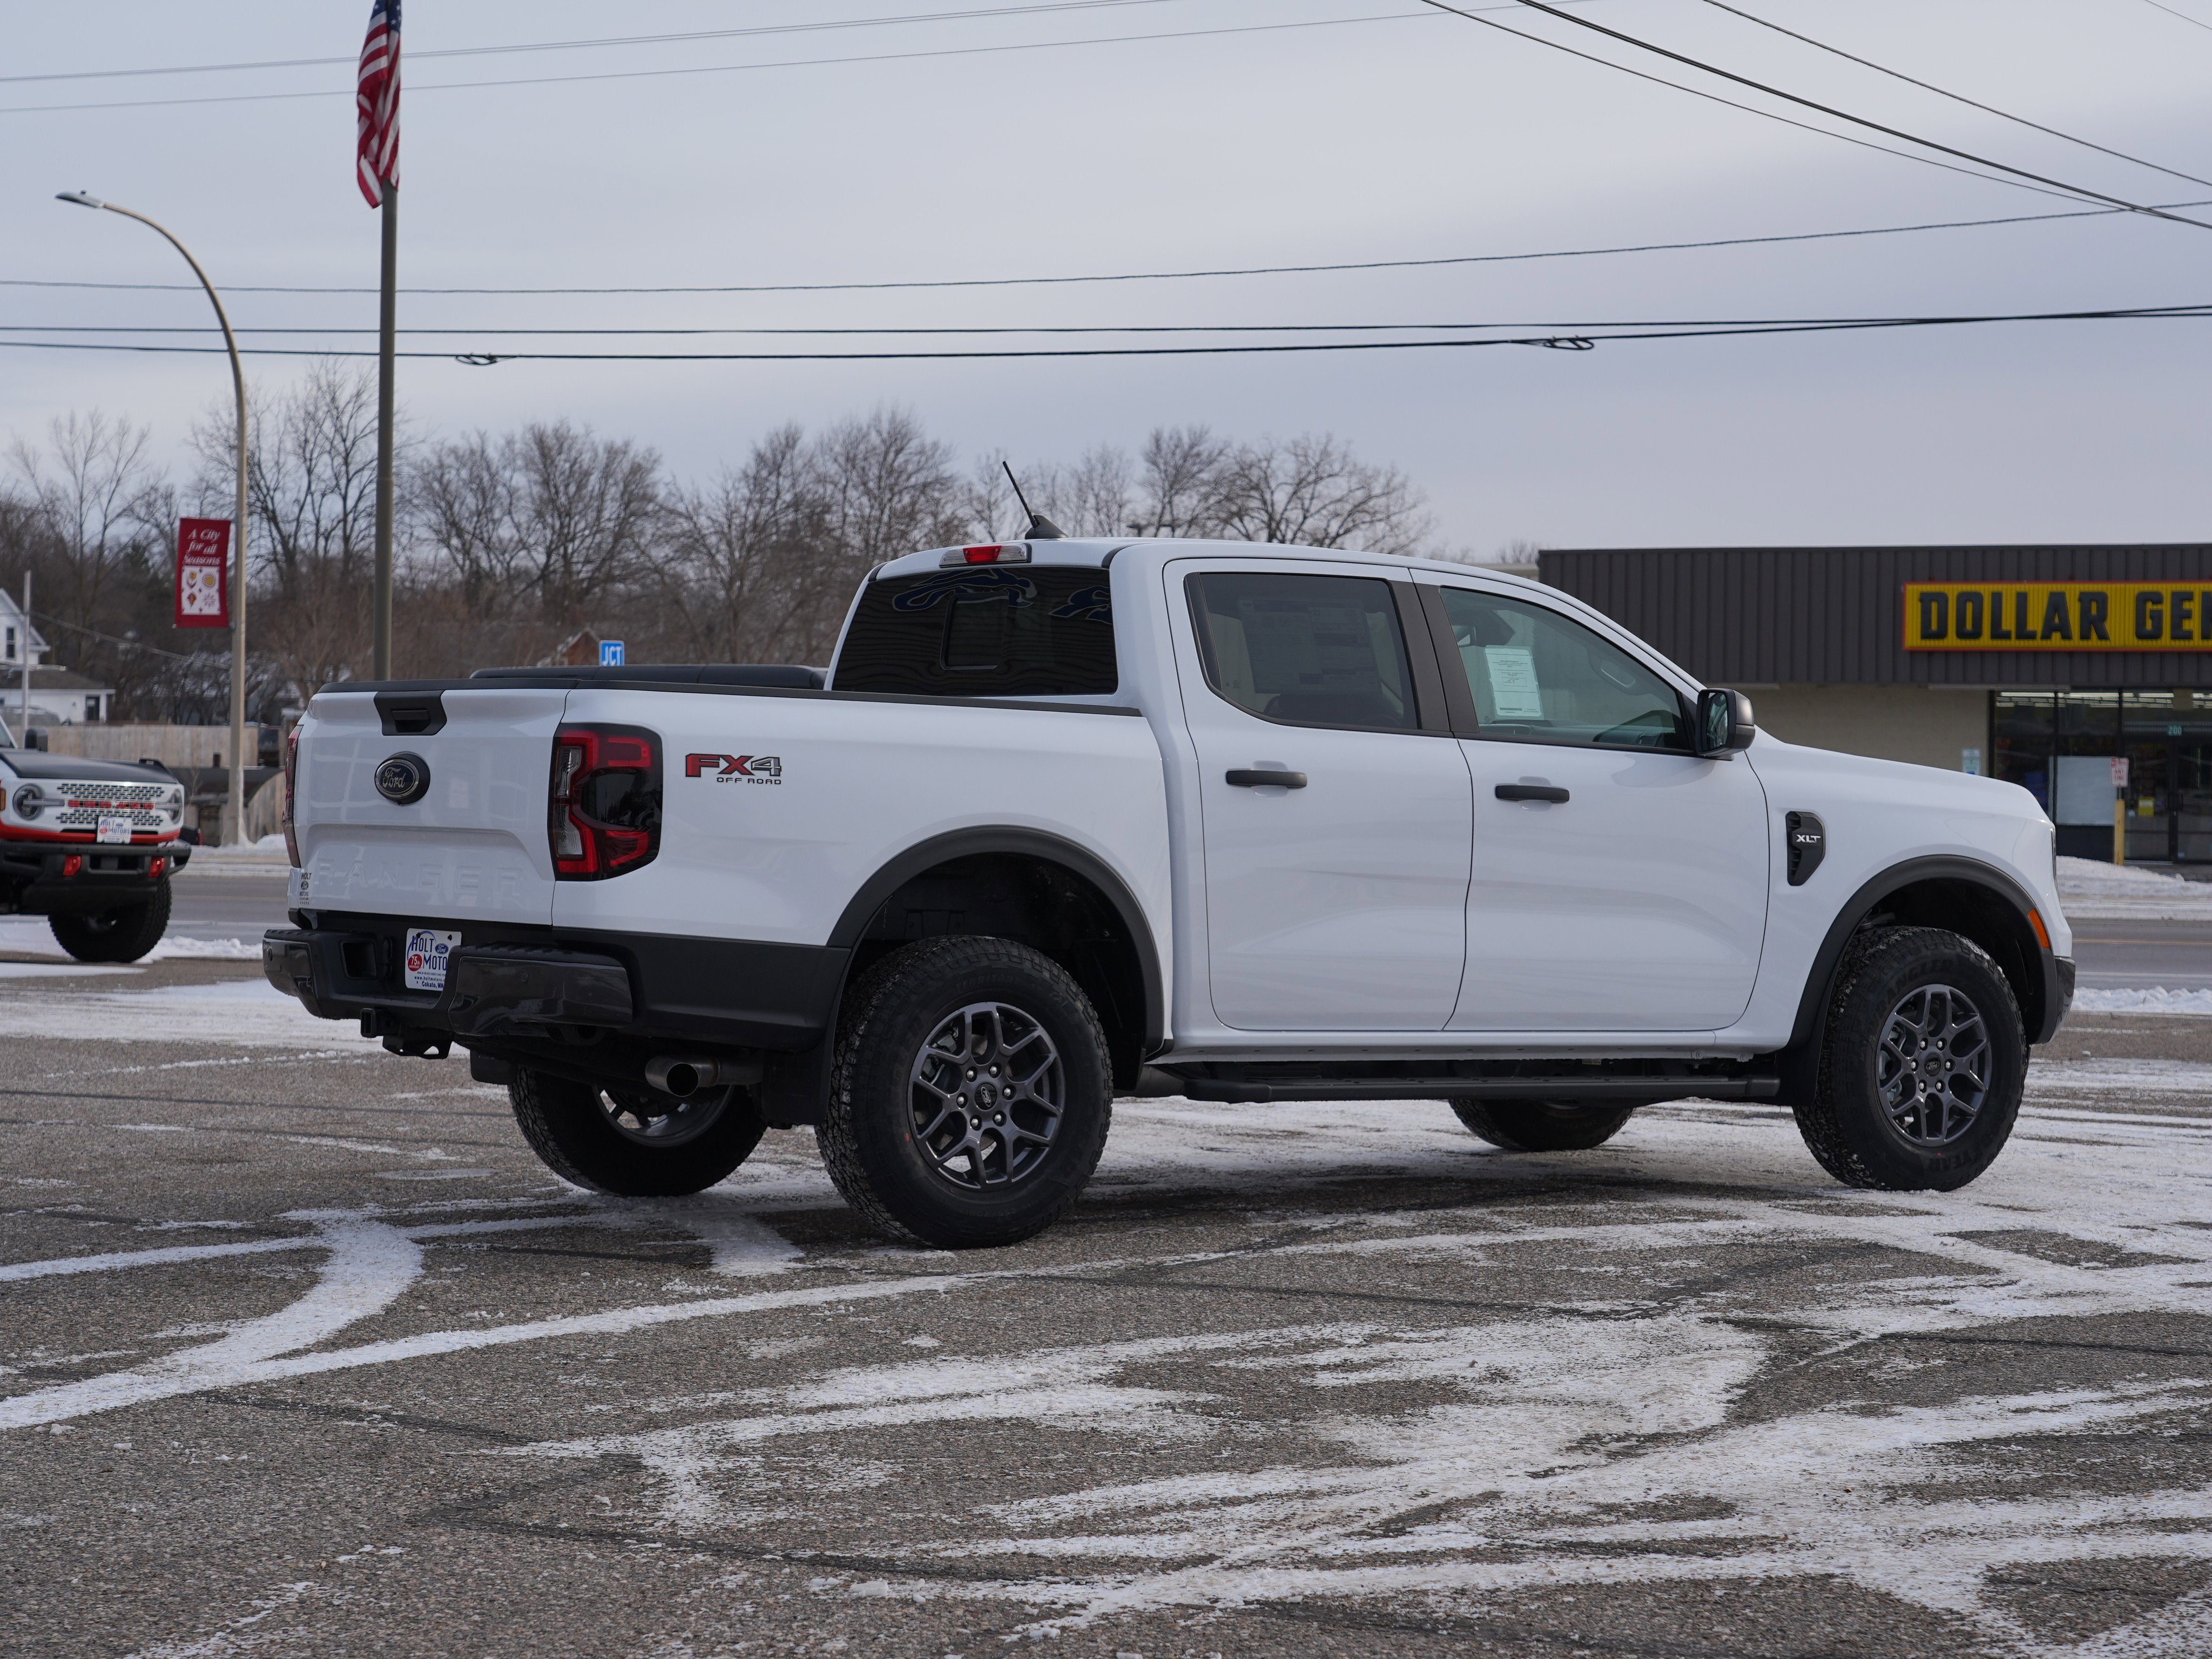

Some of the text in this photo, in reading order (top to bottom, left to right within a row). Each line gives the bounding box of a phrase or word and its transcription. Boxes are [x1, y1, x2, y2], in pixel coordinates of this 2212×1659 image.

[188, 528, 220, 543] A City
[187, 540, 217, 555] for all
[183, 553, 221, 565] Seasons
[1919, 591, 2112, 641] DOLLAR
[602, 646, 622, 666] JCT
[2168, 725, 2182, 736] 200
[685, 753, 781, 778] FX4
[382, 767, 407, 788] Ford
[1796, 834, 1821, 843] XLT
[314, 858, 524, 896] RANGER
[412, 935, 434, 953] HOLT
[422, 981, 437, 989] Cokato,
